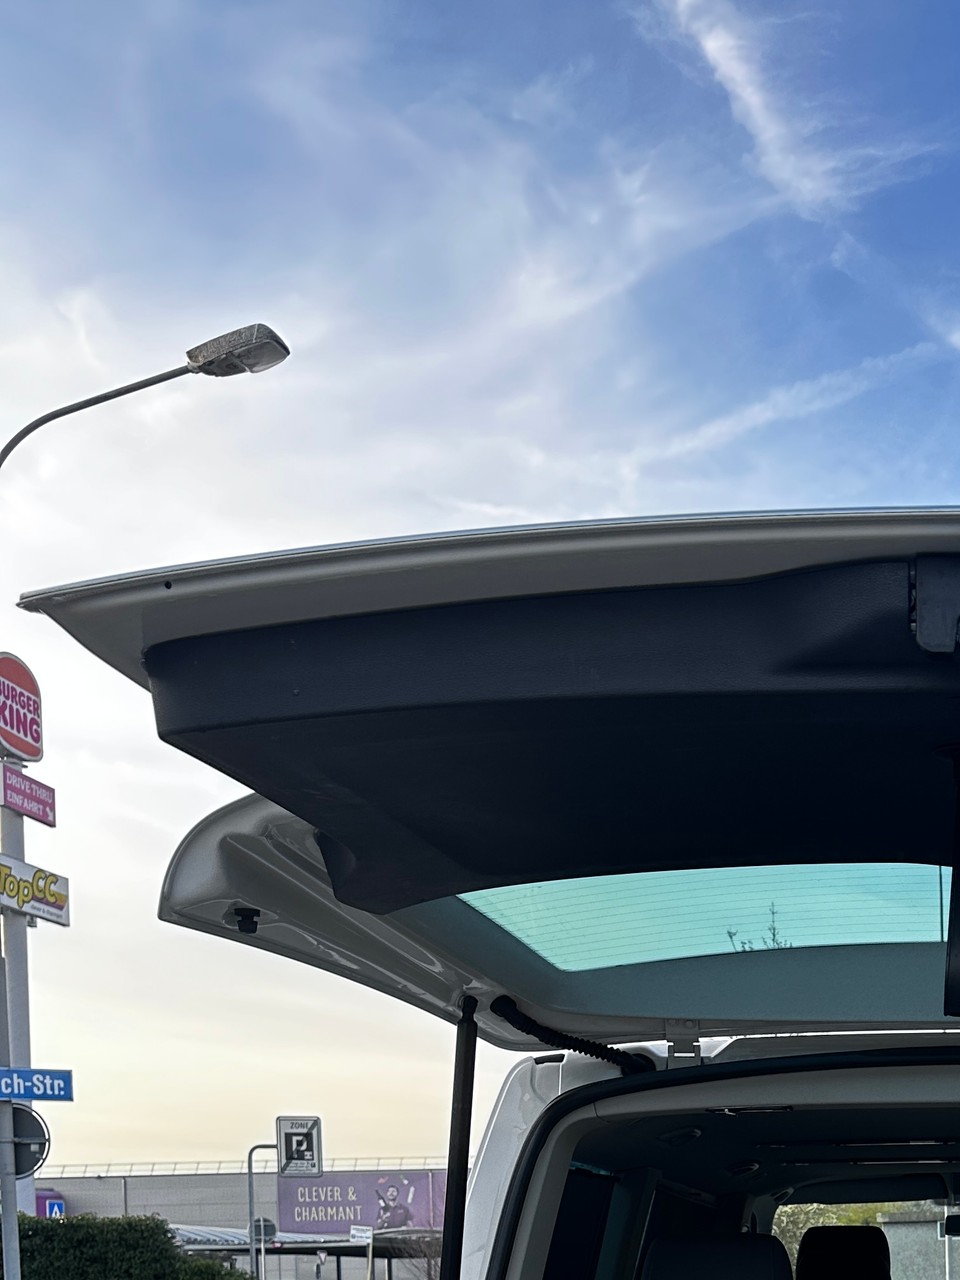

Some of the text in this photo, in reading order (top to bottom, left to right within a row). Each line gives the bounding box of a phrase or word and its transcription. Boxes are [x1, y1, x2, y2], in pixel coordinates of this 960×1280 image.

[6, 771, 53, 804] DRIVE THRU
[6, 789, 44, 816] EINFAHRT
[297, 1185, 358, 1202] CLEVER &
[294, 1205, 362, 1222] CHARMANT
